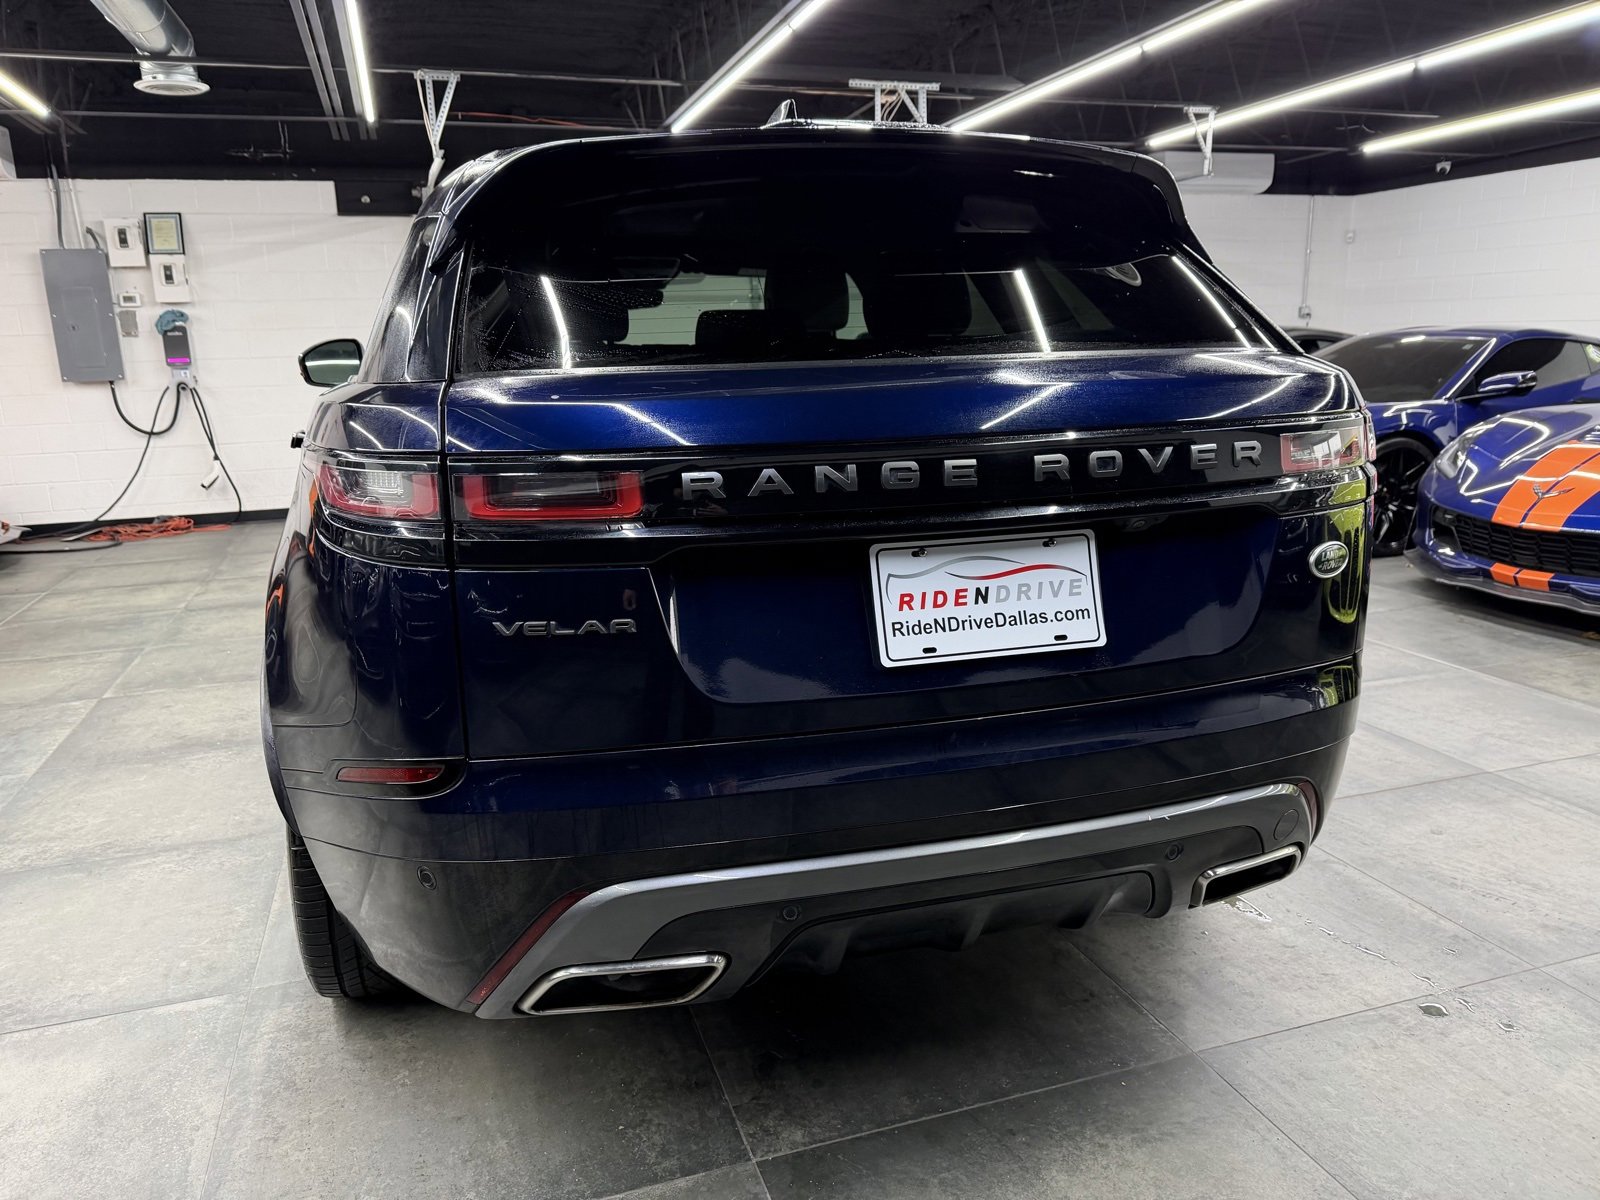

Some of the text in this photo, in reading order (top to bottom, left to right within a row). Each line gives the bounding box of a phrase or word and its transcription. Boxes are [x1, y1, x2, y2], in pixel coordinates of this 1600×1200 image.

[681, 440, 1262, 499] RANGE ROVER
[898, 577, 1083, 611] RIDENDRIVE
[492, 618, 637, 637] VELAR
[891, 607, 1091, 637] RideNDriveDallas.com
